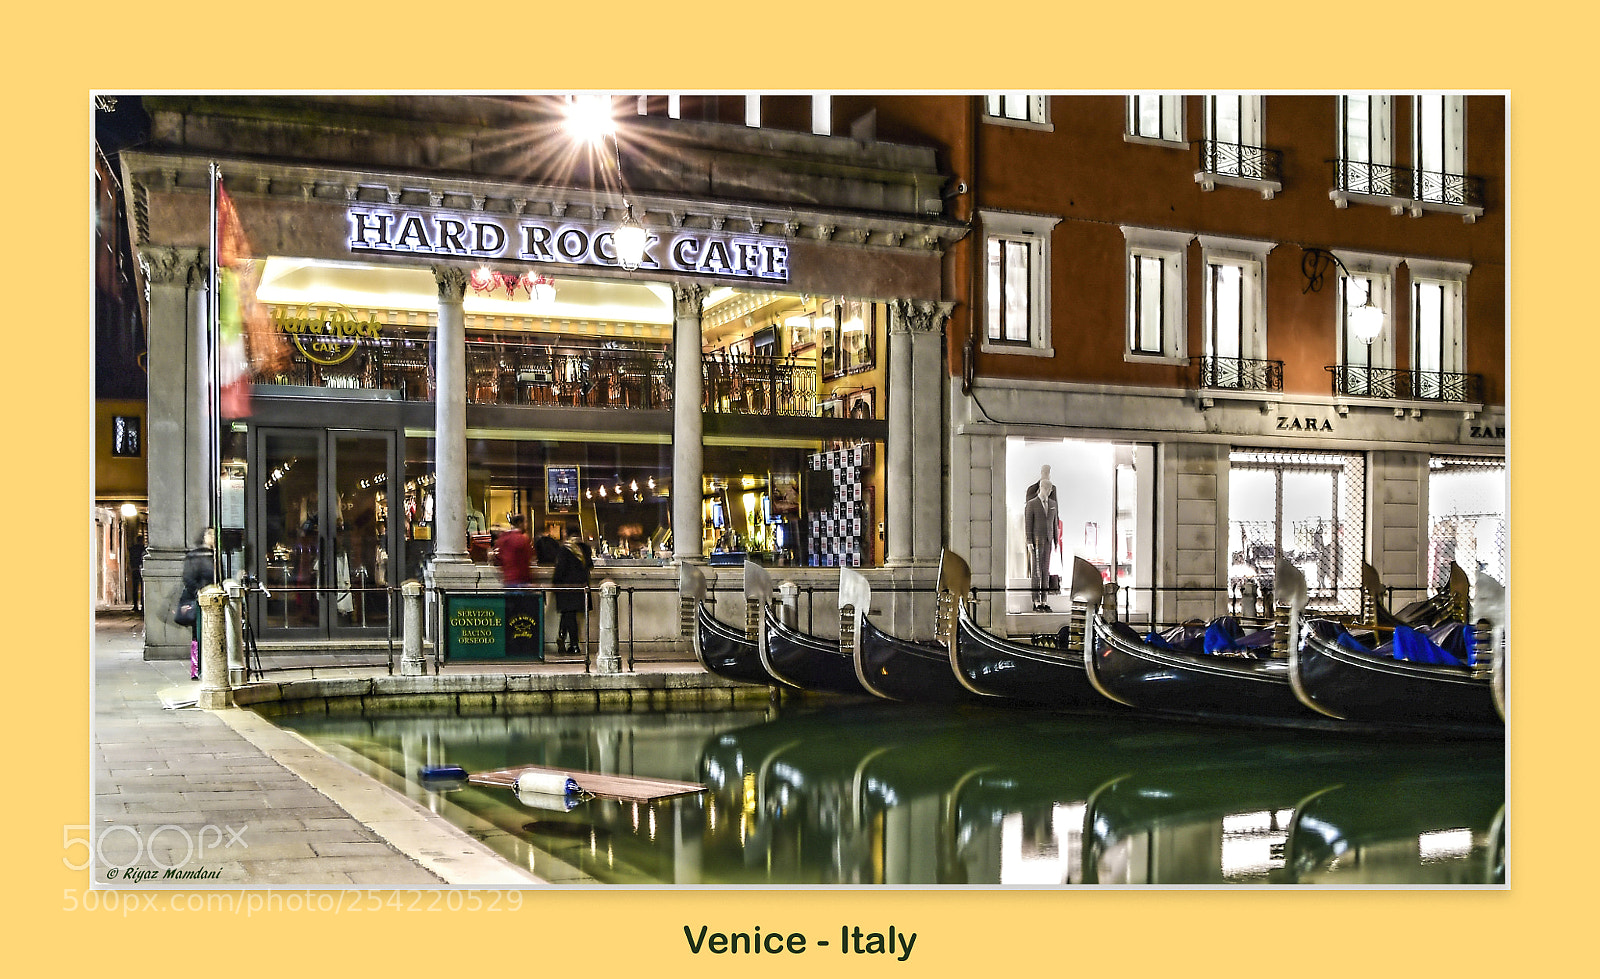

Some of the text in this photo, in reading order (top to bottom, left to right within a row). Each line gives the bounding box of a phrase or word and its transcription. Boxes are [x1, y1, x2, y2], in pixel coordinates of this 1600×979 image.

[350, 209, 508, 258] HARD
[673, 235, 788, 281] CAFE
[270, 308, 383, 340] Hard Rock
[1276, 416, 1335, 432] ZARA
[450, 618, 502, 627] GONDOLE
[462, 629, 492, 637] BACINO
